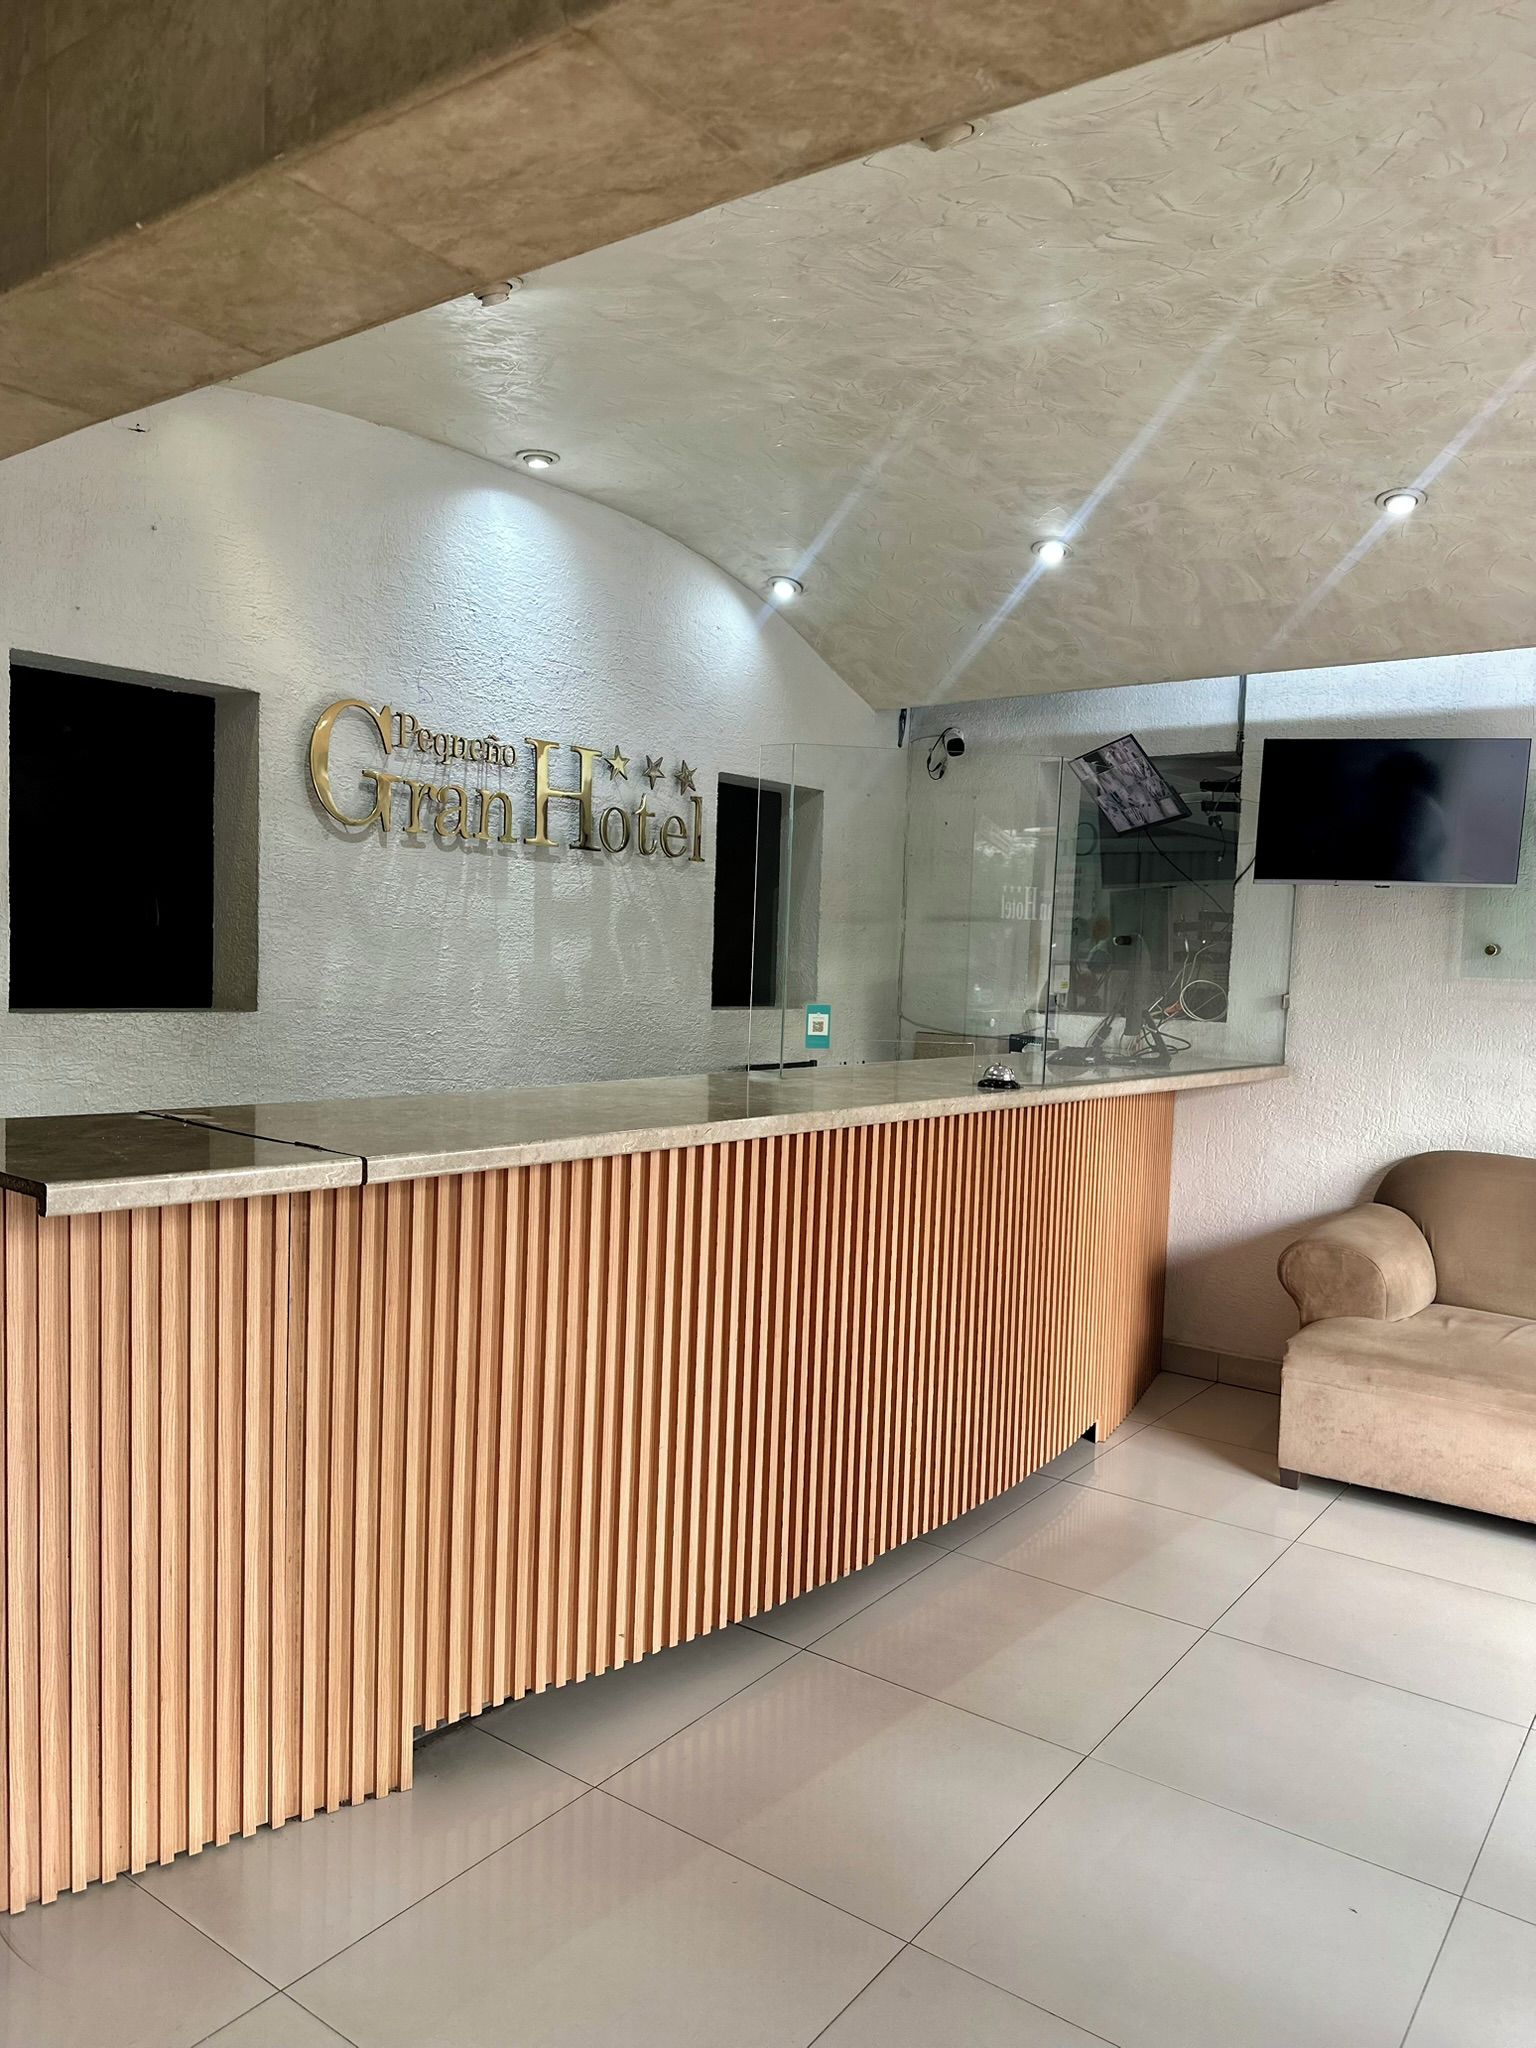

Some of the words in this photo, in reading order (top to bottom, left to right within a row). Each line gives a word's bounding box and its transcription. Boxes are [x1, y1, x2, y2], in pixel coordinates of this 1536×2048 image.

[309, 699, 518, 843] Gran
[523, 737, 706, 862] Hotel
[392, 711, 517, 767] Pequeño
